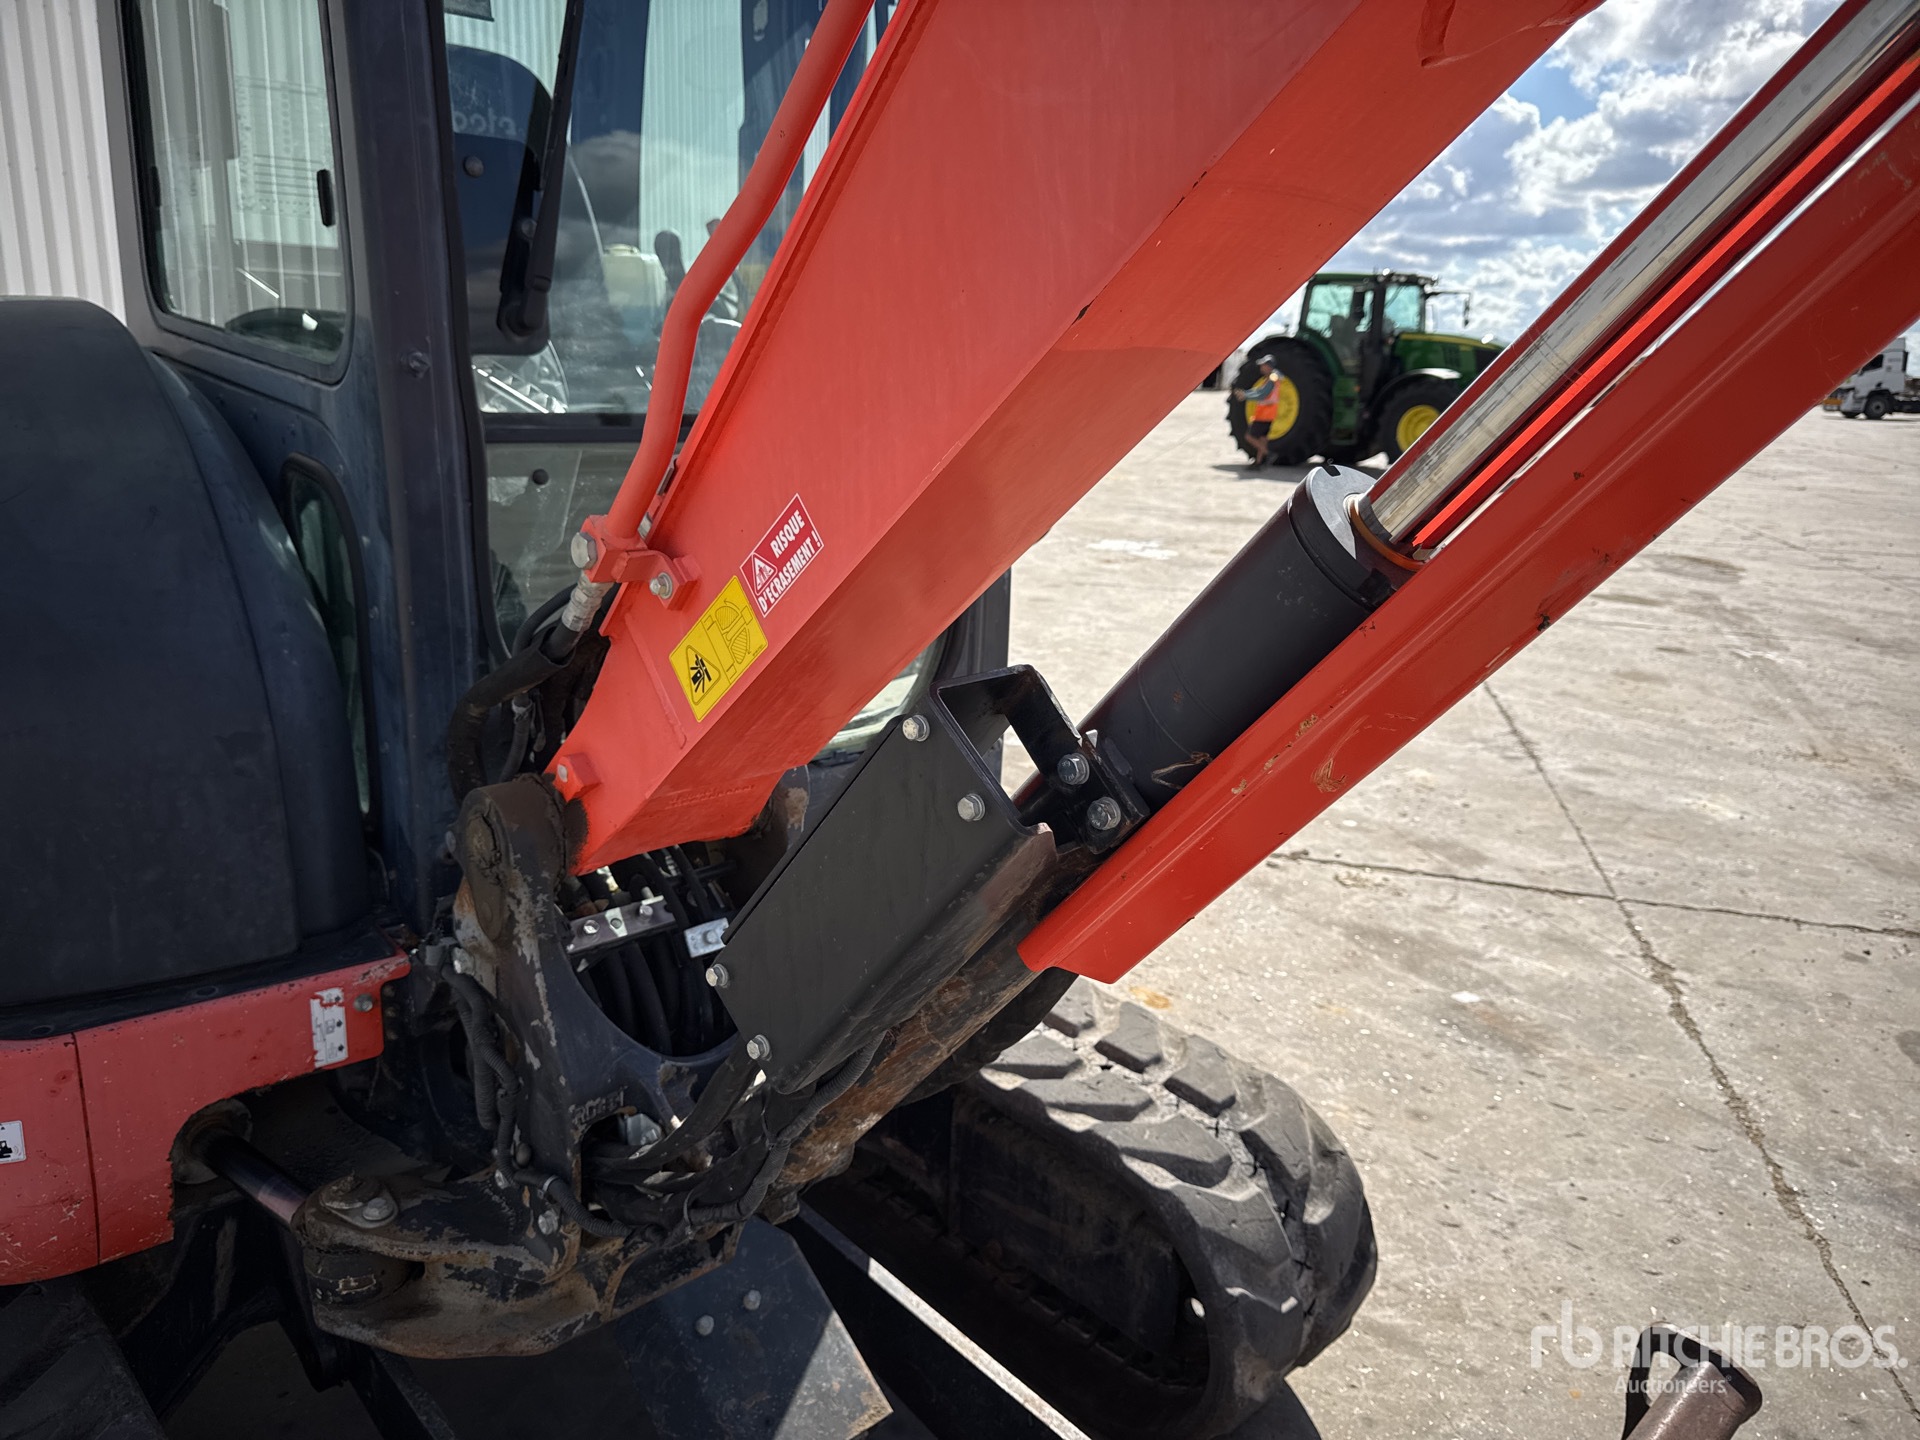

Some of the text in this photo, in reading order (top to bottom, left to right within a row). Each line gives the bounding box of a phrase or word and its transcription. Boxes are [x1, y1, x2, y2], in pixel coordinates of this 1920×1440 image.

[770, 510, 805, 558] RISQUE
[758, 530, 822, 613] D'ECRASEMENT !
